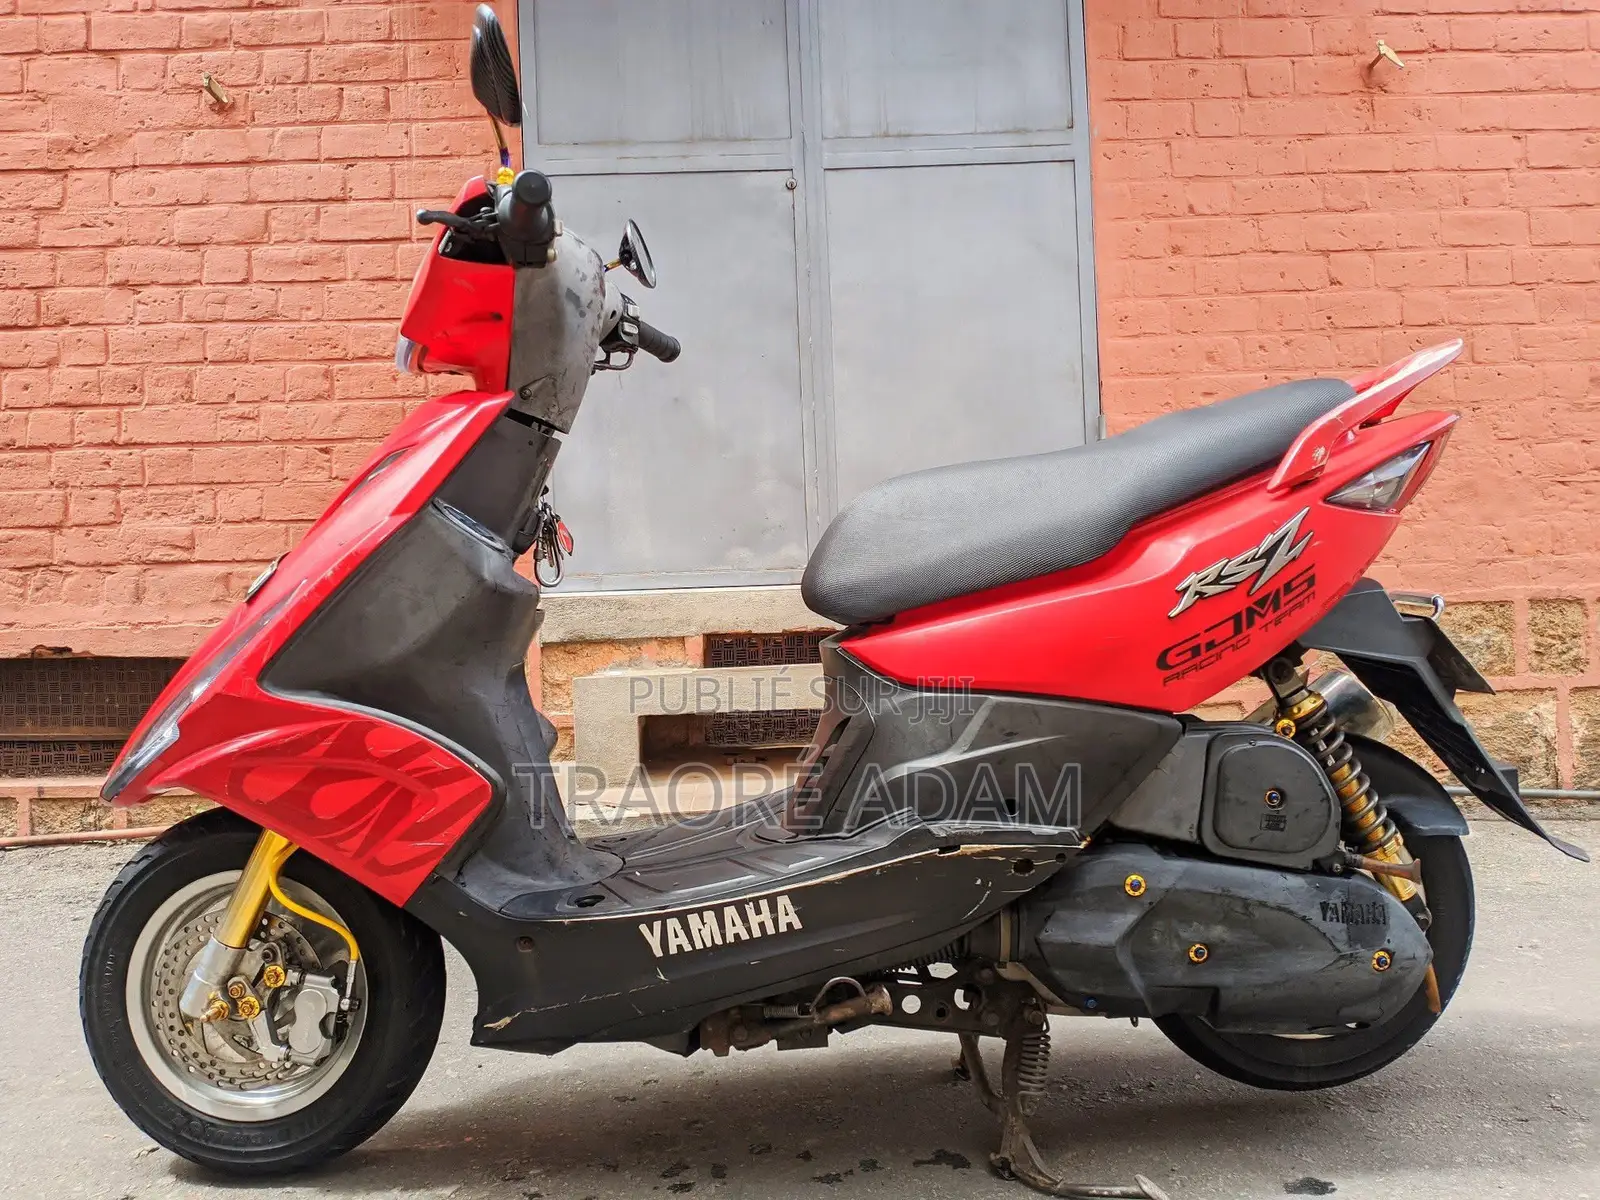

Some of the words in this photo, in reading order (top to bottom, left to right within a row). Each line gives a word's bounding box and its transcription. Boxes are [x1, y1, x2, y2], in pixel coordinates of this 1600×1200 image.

[1168, 506, 1315, 619] RSZ
[1258, 590, 1316, 633] TEAM
[639, 895, 803, 958] YAMAHA
